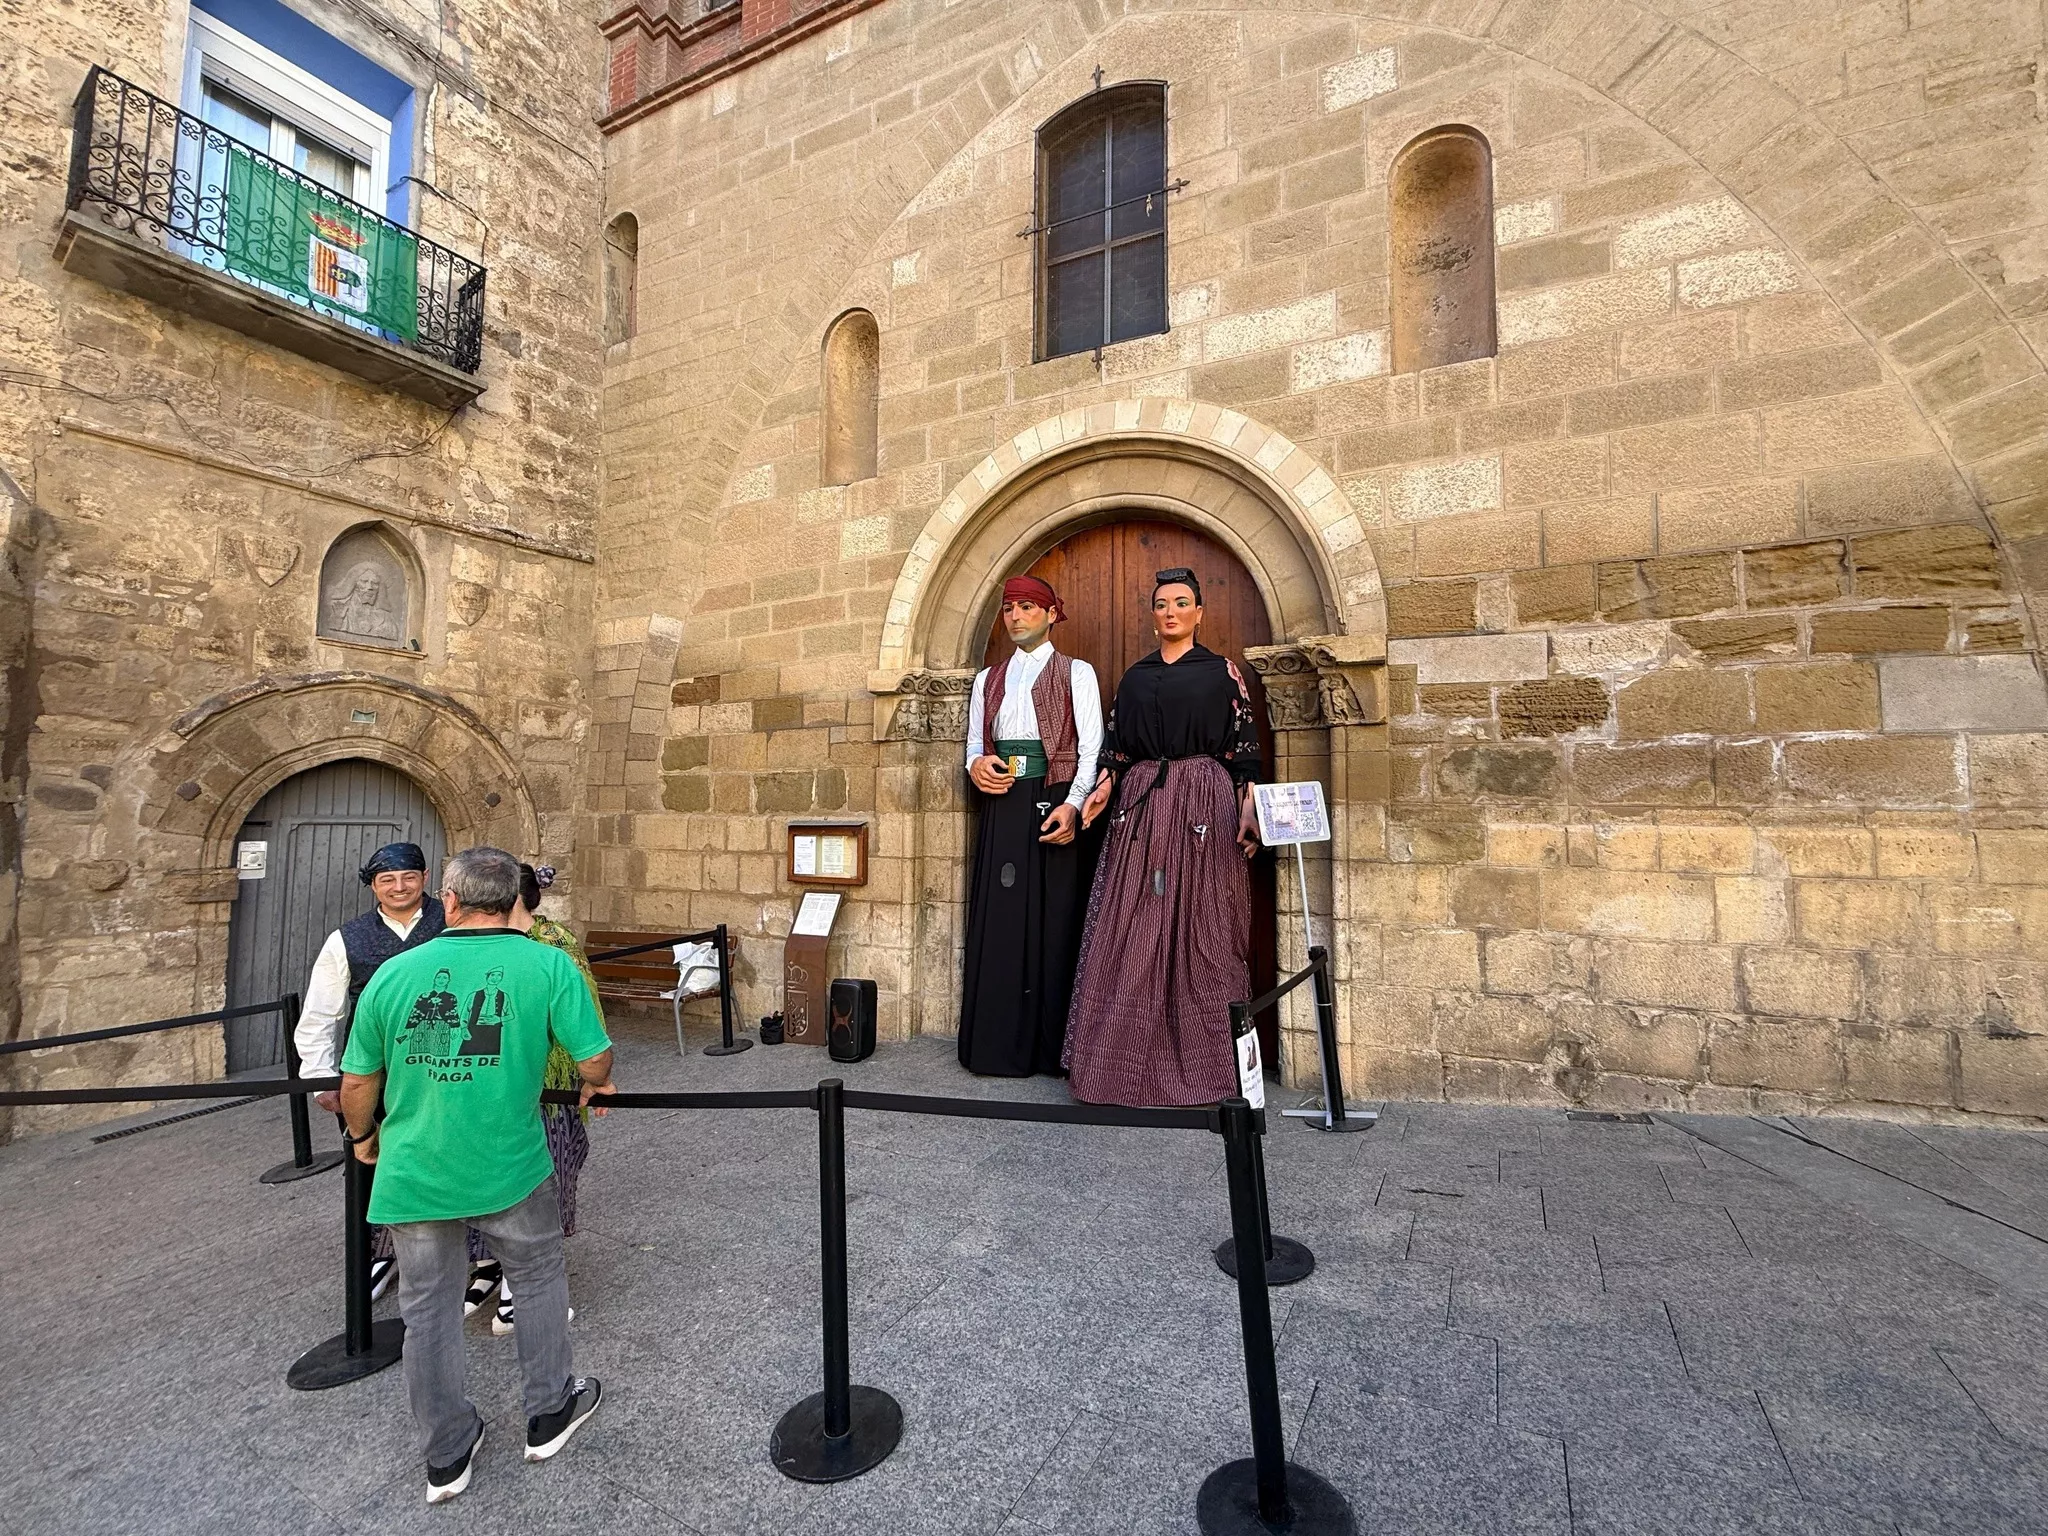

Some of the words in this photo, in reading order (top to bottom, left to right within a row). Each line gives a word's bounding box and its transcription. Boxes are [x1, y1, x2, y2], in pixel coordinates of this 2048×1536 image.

[405, 1055, 473, 1067] GIGANTS
[477, 1057, 500, 1066] DE
[428, 1068, 473, 1082] FRAGA
